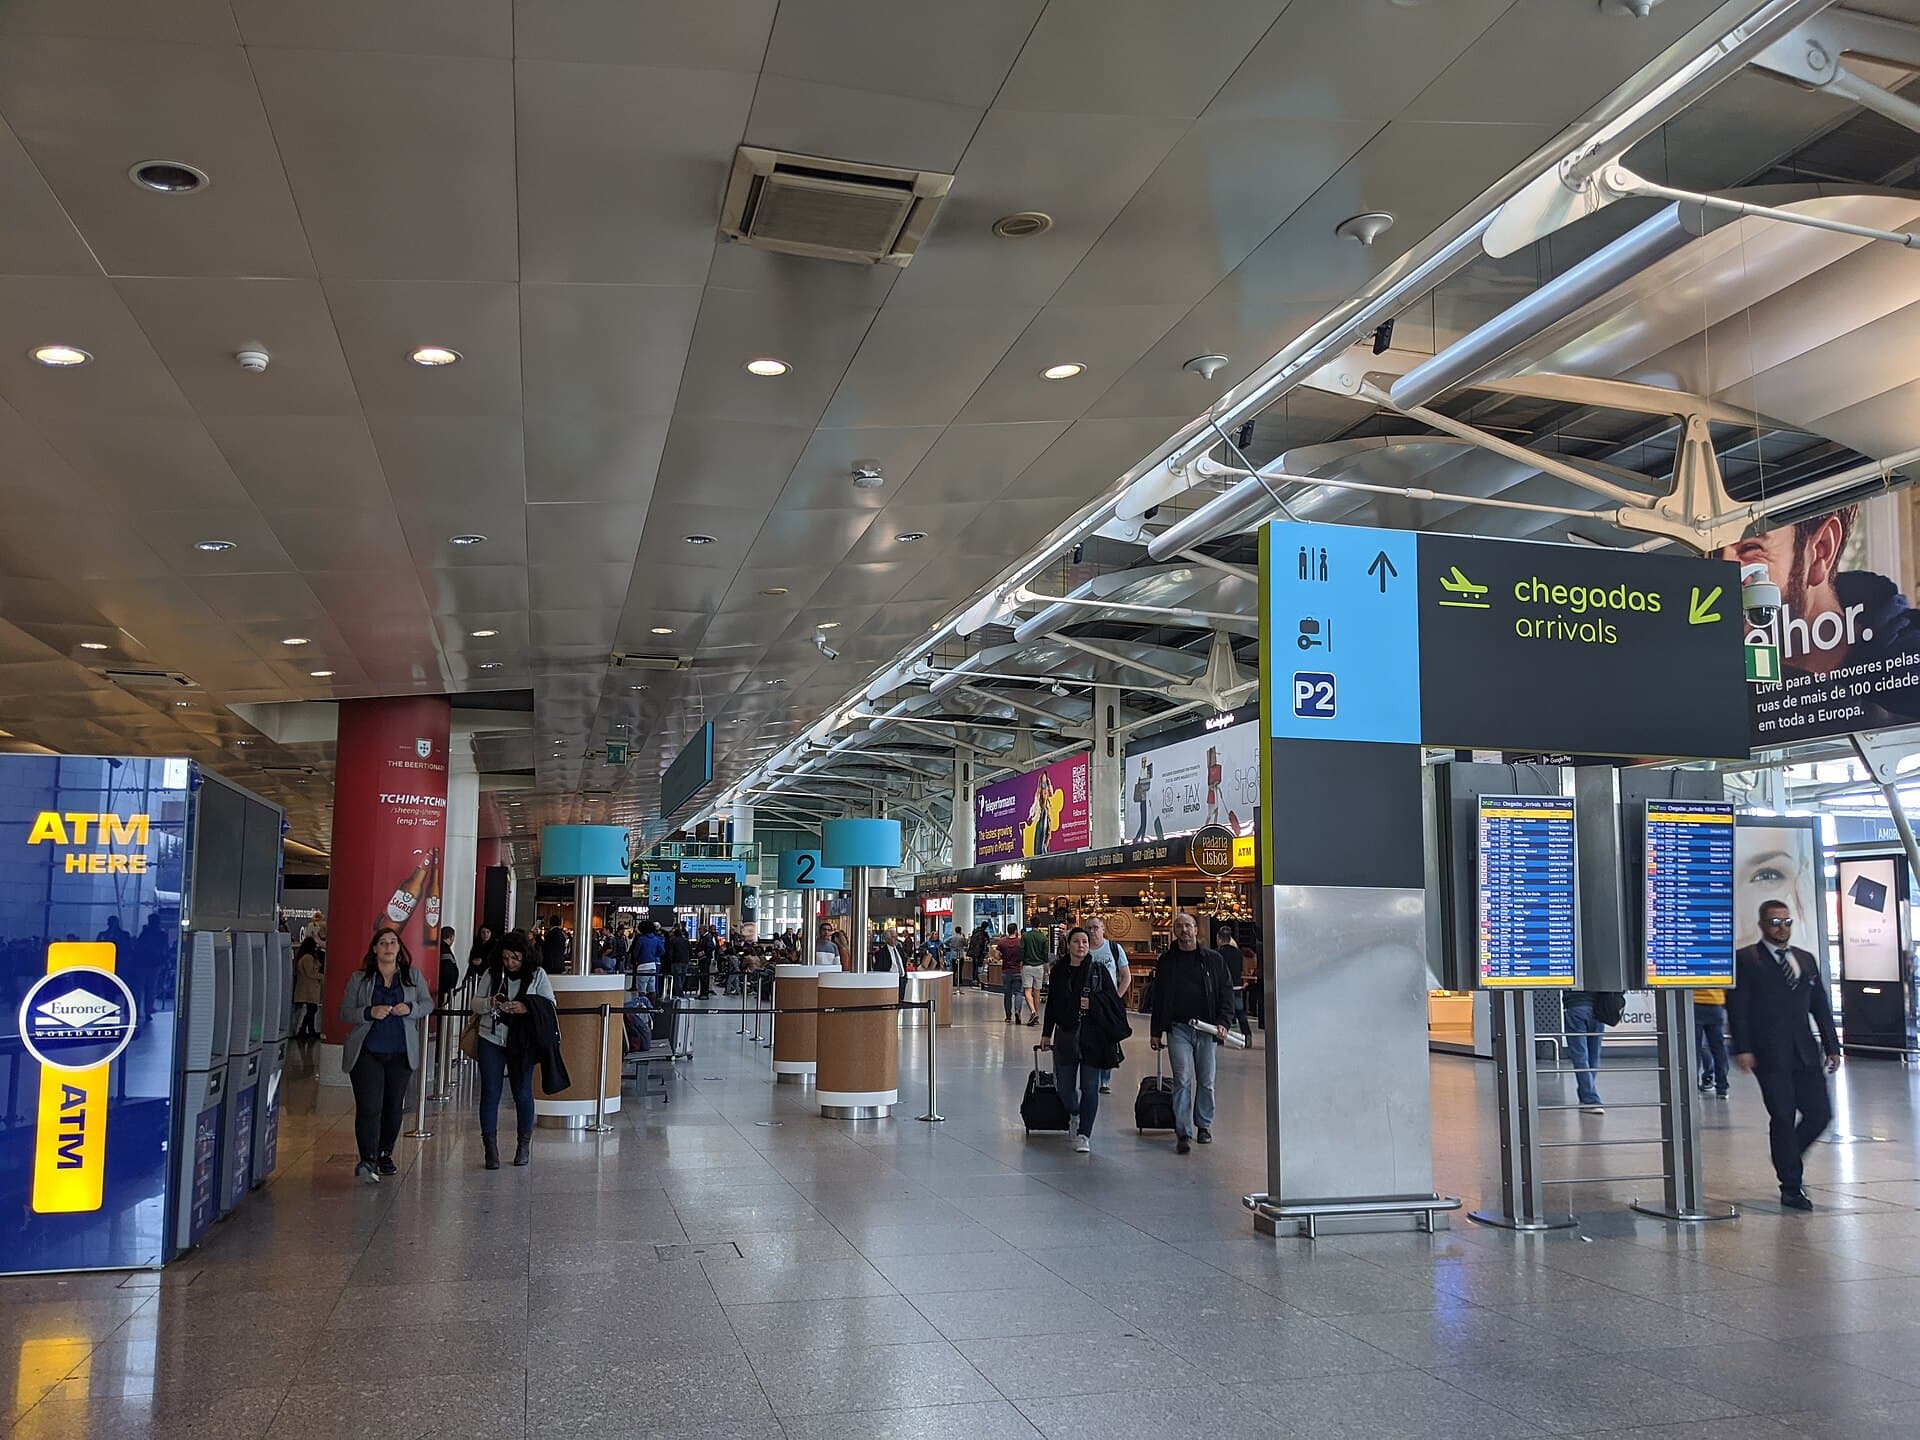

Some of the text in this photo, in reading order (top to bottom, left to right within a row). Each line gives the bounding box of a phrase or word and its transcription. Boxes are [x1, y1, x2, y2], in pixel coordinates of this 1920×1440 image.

[1514, 577, 1662, 613] chegadas
[1516, 615, 1617, 644] arrivals
[1756, 652, 1920, 695] Livre para te moveres pelas
[1296, 681, 1334, 709] P2
[1757, 700, 1780, 713] ruas
[1783, 695, 1797, 708] de
[1801, 689, 1827, 705] mais
[1831, 685, 1846, 699] de
[1849, 682, 1871, 697] 100
[1758, 705, 1864, 731] em toda a Europa.
[388, 760, 403, 768] THE
[1184, 783, 1201, 804] TAX
[27, 812, 150, 845] ATM
[396, 815, 418, 826] (eng.)
[998, 825, 1012, 841] growing
[621, 833, 630, 871] 3
[979, 844, 994, 857] company
[1238, 847, 1251, 856] ATM
[65, 853, 147, 874] HERE
[797, 854, 816, 884] 2
[691, 877, 720, 885] chegadas
[926, 897, 953, 913] RELAY
[51, 1001, 108, 1014] Euronet
[57, 1083, 87, 1170] ATM
